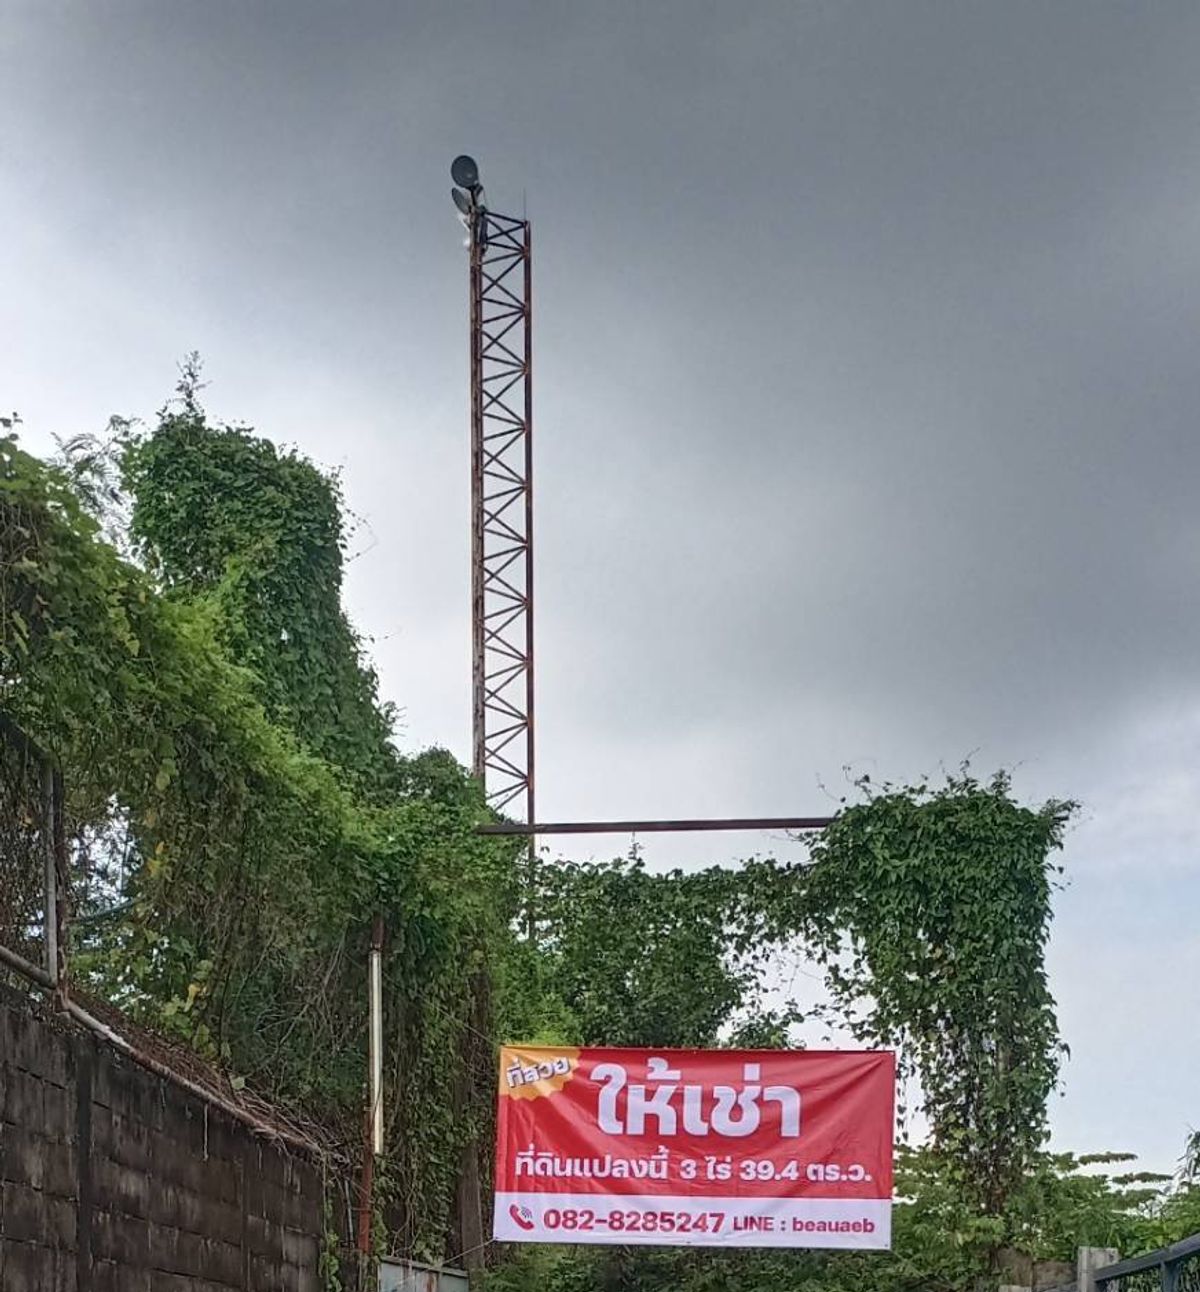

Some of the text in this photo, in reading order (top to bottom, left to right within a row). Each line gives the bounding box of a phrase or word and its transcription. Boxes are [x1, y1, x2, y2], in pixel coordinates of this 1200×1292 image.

[506, 1056, 572, 1088] ที่สวย
[590, 1057, 801, 1137] ให้เช่า
[515, 1144, 873, 1182] ที่ดินแปลงนี้ 3 ไร่ 39.4 ตร.ว.
[543, 1209, 725, 1234] 082-8285247
[733, 1216, 774, 1232] LINE
[792, 1217, 875, 1233] beauaeb
